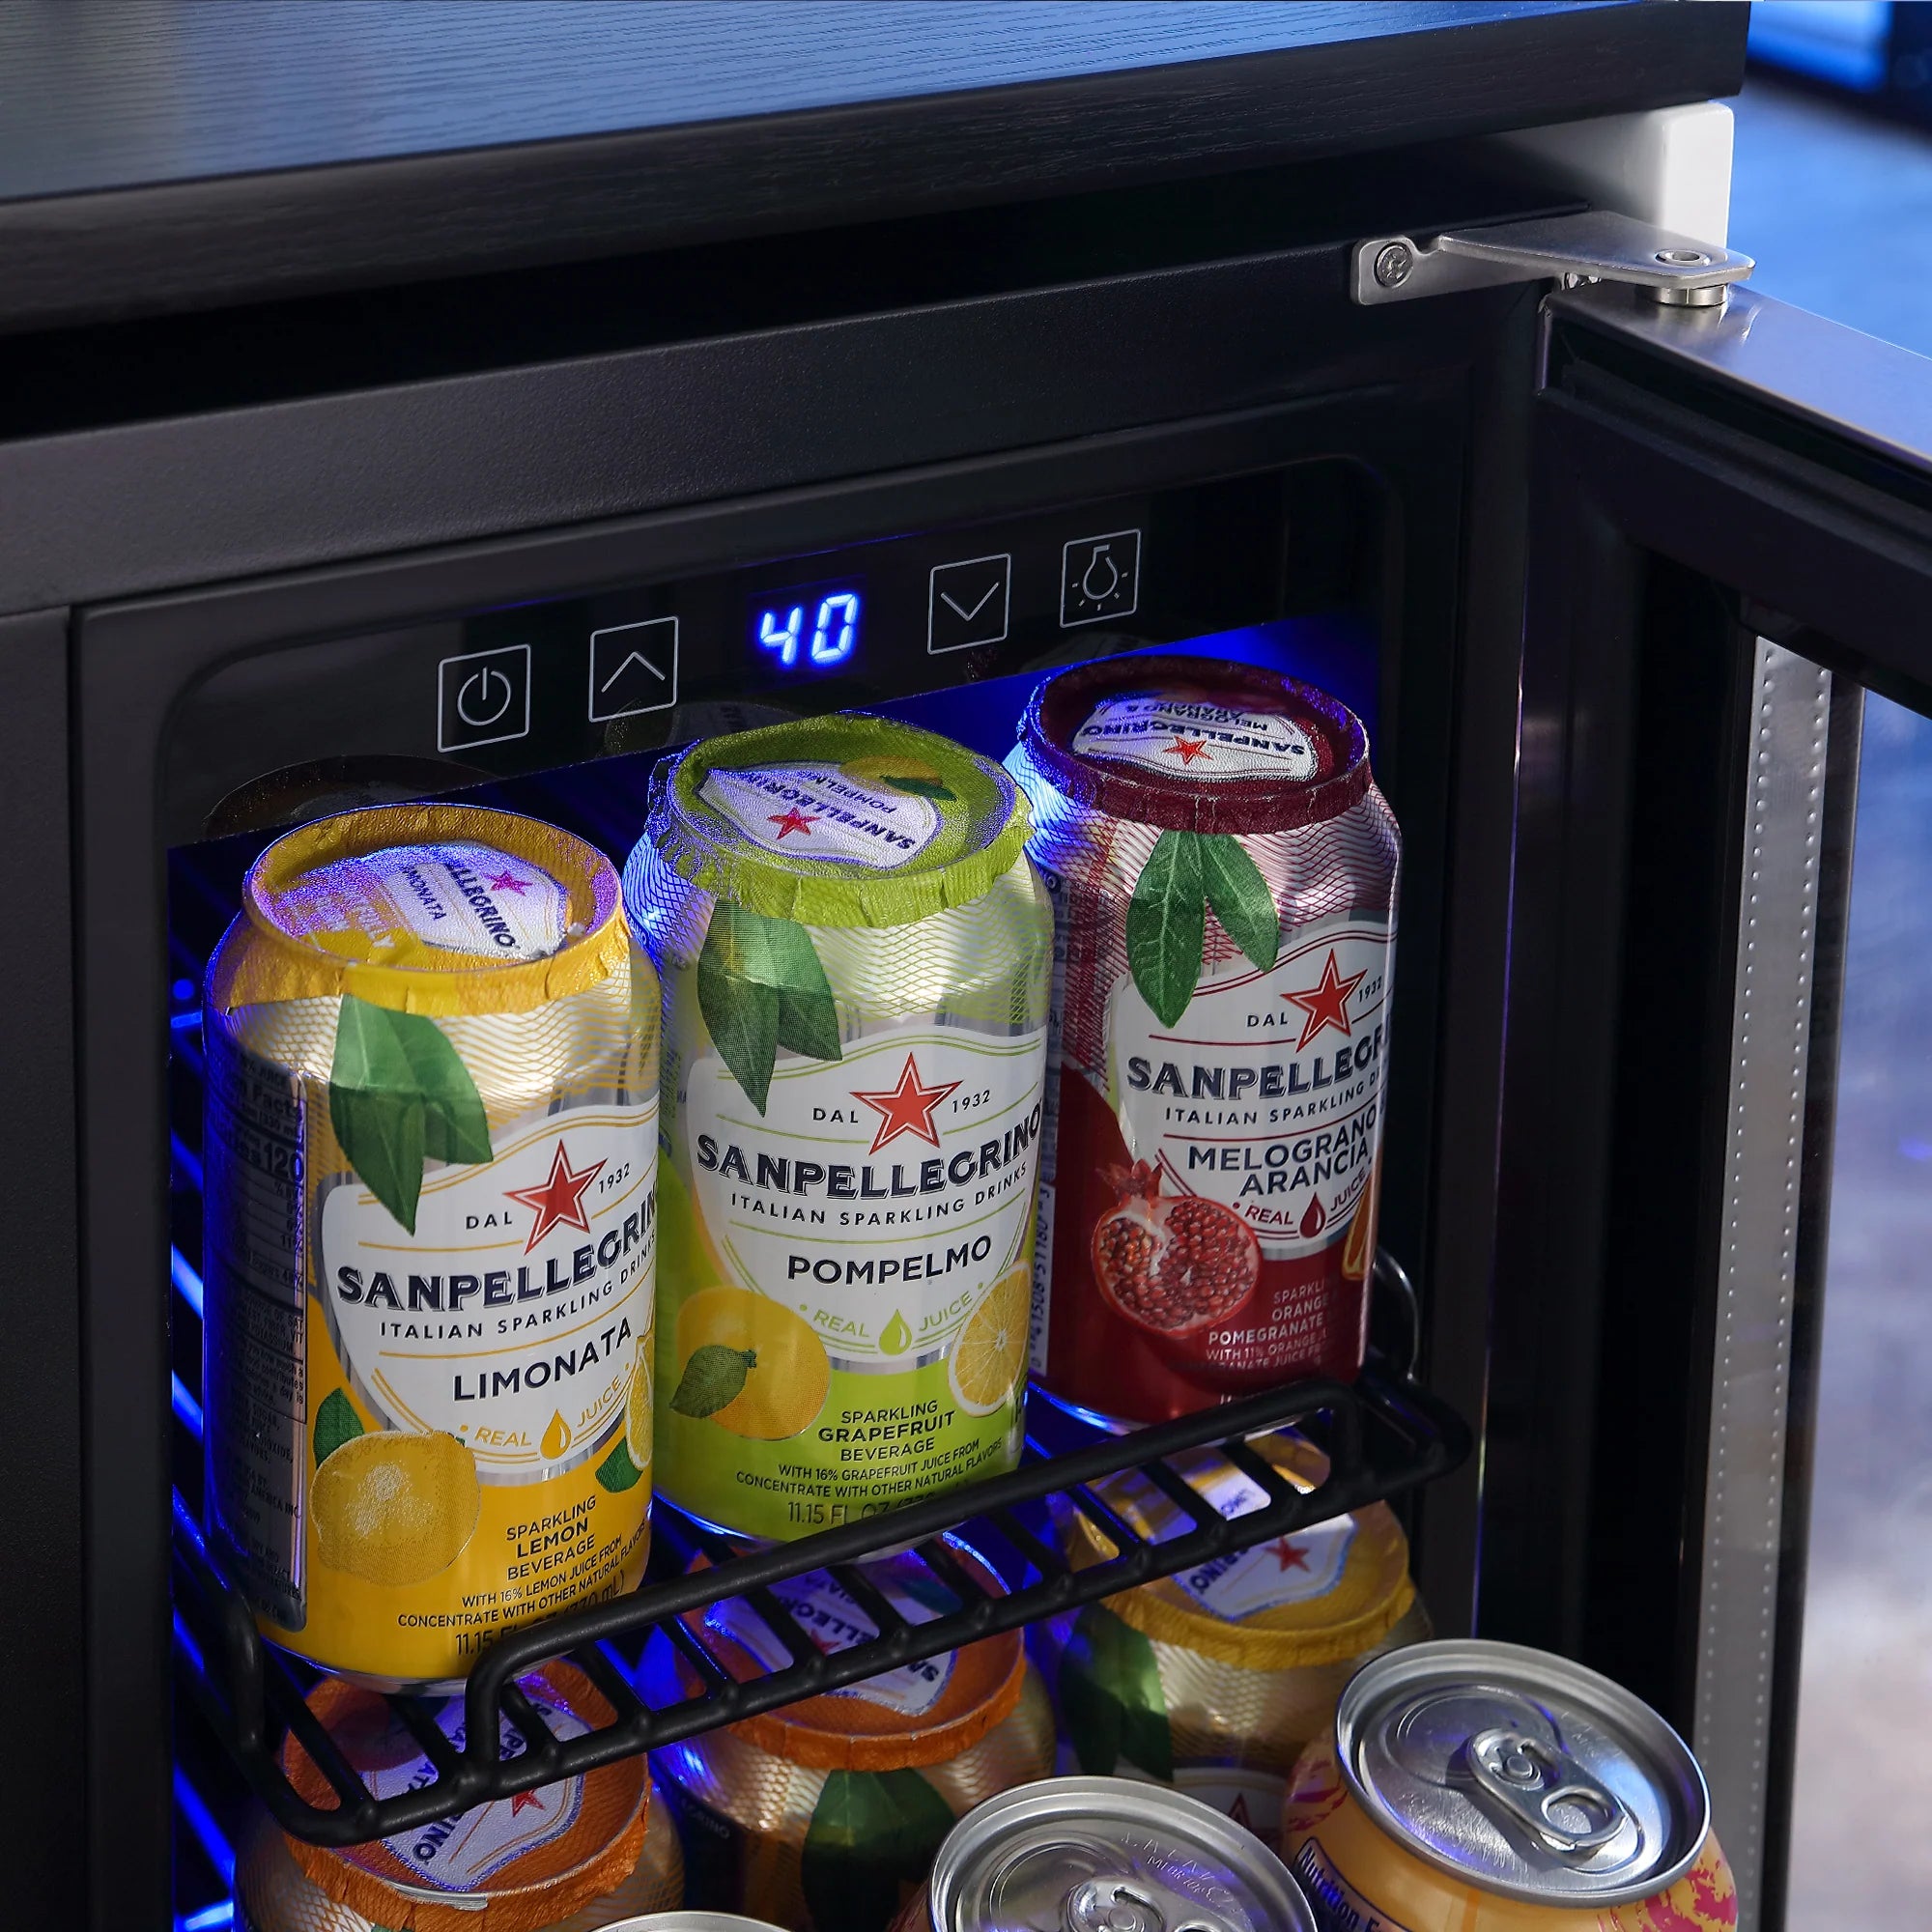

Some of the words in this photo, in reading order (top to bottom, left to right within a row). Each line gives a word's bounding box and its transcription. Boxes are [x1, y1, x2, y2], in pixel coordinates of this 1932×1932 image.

[761, 594, 856, 664] 40
[1082, 722, 1305, 756] SANPELLEGRINO
[1246, 1011, 1289, 1028] DAL
[1357, 976, 1382, 1003] 1932
[812, 1108, 859, 1123] DAL
[952, 1090, 991, 1113] 1932
[1166, 1107, 1257, 1124] ITALIAN
[1269, 1081, 1364, 1122] SPARKLING
[264, 1142, 304, 1182] 120
[696, 1100, 1041, 1201] SANPELLEGRINO
[1188, 1104, 1377, 1171] MELOGRANO
[1239, 1137, 1368, 1197] ARANCIA
[466, 1210, 513, 1230] DAL
[598, 1162, 630, 1194] 1932
[731, 1193, 825, 1224] ITALIAN
[839, 1198, 965, 1226] SPARKLING
[974, 1162, 1027, 1206] DRINKS
[1245, 1206, 1293, 1225] REAL
[1330, 1167, 1365, 1212] JUICE
[336, 1180, 656, 1312] SANPELLEGRIN
[787, 1235, 992, 1286] POMPELMO
[380, 1321, 483, 1340] ITALIAN
[497, 1282, 614, 1334] SPARKLING
[620, 1229, 655, 1285] DRINKS
[812, 1309, 870, 1338] REAL
[919, 1291, 973, 1332] JUICE
[1208, 1312, 1323, 1345] POMEGRANATE
[452, 1316, 633, 1402] LIMONATA
[1207, 1346, 1240, 1360] WITH
[1267, 1332, 1316, 1354] ORANGE
[473, 1426, 532, 1448] REAL
[576, 1374, 621, 1428] JUICE
[818, 1410, 955, 1443] GRAPEFRUIT
[840, 1400, 938, 1424] SPARKLING
[735, 1470, 831, 1498] CONCENTRATE
[835, 1485, 868, 1498] WITH
[871, 1480, 912, 1497] OTHER
[915, 1465, 964, 1490] NATURAL
[965, 1439, 1003, 1471] FLAVORS
[778, 1463, 812, 1481] WITH
[815, 1467, 838, 1482] 16%
[841, 1462, 919, 1482] GRAPEFRUIT
[921, 1452, 951, 1472] JUICE
[952, 1438, 980, 1462] FROM
[840, 1437, 935, 1462] BEVERAGE
[506, 1494, 597, 1542] SPARKLING
[517, 1517, 588, 1559] LEMON
[787, 1501, 824, 1524] 11.15
[462, 1593, 497, 1608] WITH
[500, 1586, 523, 1604] 16%
[526, 1573, 566, 1598] LEMON
[569, 1556, 597, 1581] JUICE
[599, 1534, 623, 1563] FROM
[507, 1534, 595, 1581] BEVERAGE
[397, 1609, 498, 1628] CONCENTRATE
[502, 1604, 535, 1620] WITH
[538, 1587, 576, 1610] OTHER
[579, 1555, 620, 1593] NATURAL
